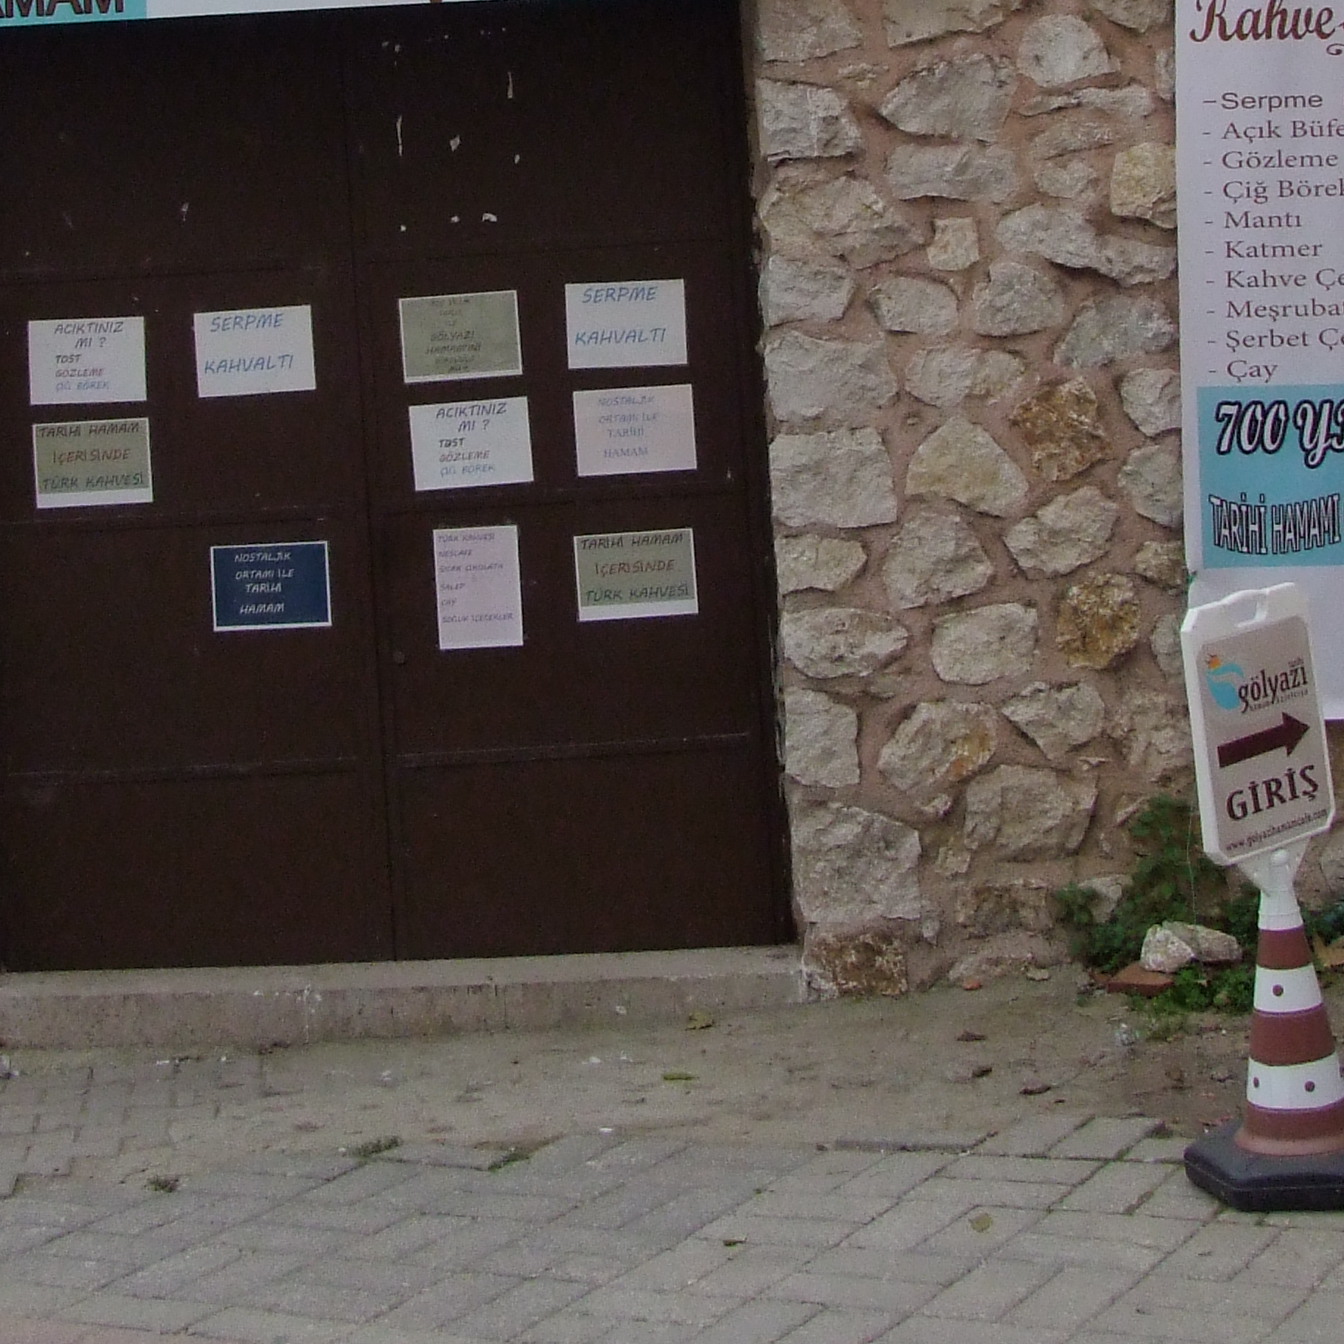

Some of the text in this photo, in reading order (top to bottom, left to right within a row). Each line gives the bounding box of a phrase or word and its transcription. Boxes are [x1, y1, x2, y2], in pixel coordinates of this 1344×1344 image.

[1220, 92, 1323, 113] Serpme
[1221, 122, 1281, 144] Açık
[1222, 151, 1338, 169] Gözleme
[1222, 179, 1268, 205] Çiğ
[1224, 211, 1302, 229] Mantı
[1224, 240, 1323, 259] Katmer
[1225, 268, 1307, 288] Kahve
[582, 286, 658, 303] SERPME
[210, 313, 284, 332] SERPME
[575, 328, 666, 345] KAHVALTI
[1226, 329, 1309, 352] Şerbet
[204, 354, 294, 374] KAHVALTI
[1227, 359, 1278, 383] Çay
[1215, 399, 1290, 455] 700
[1209, 492, 1268, 555] TARİHİ
[1271, 493, 1341, 554] HAMAMI
[1226, 764, 1320, 822] GİRİŞ
